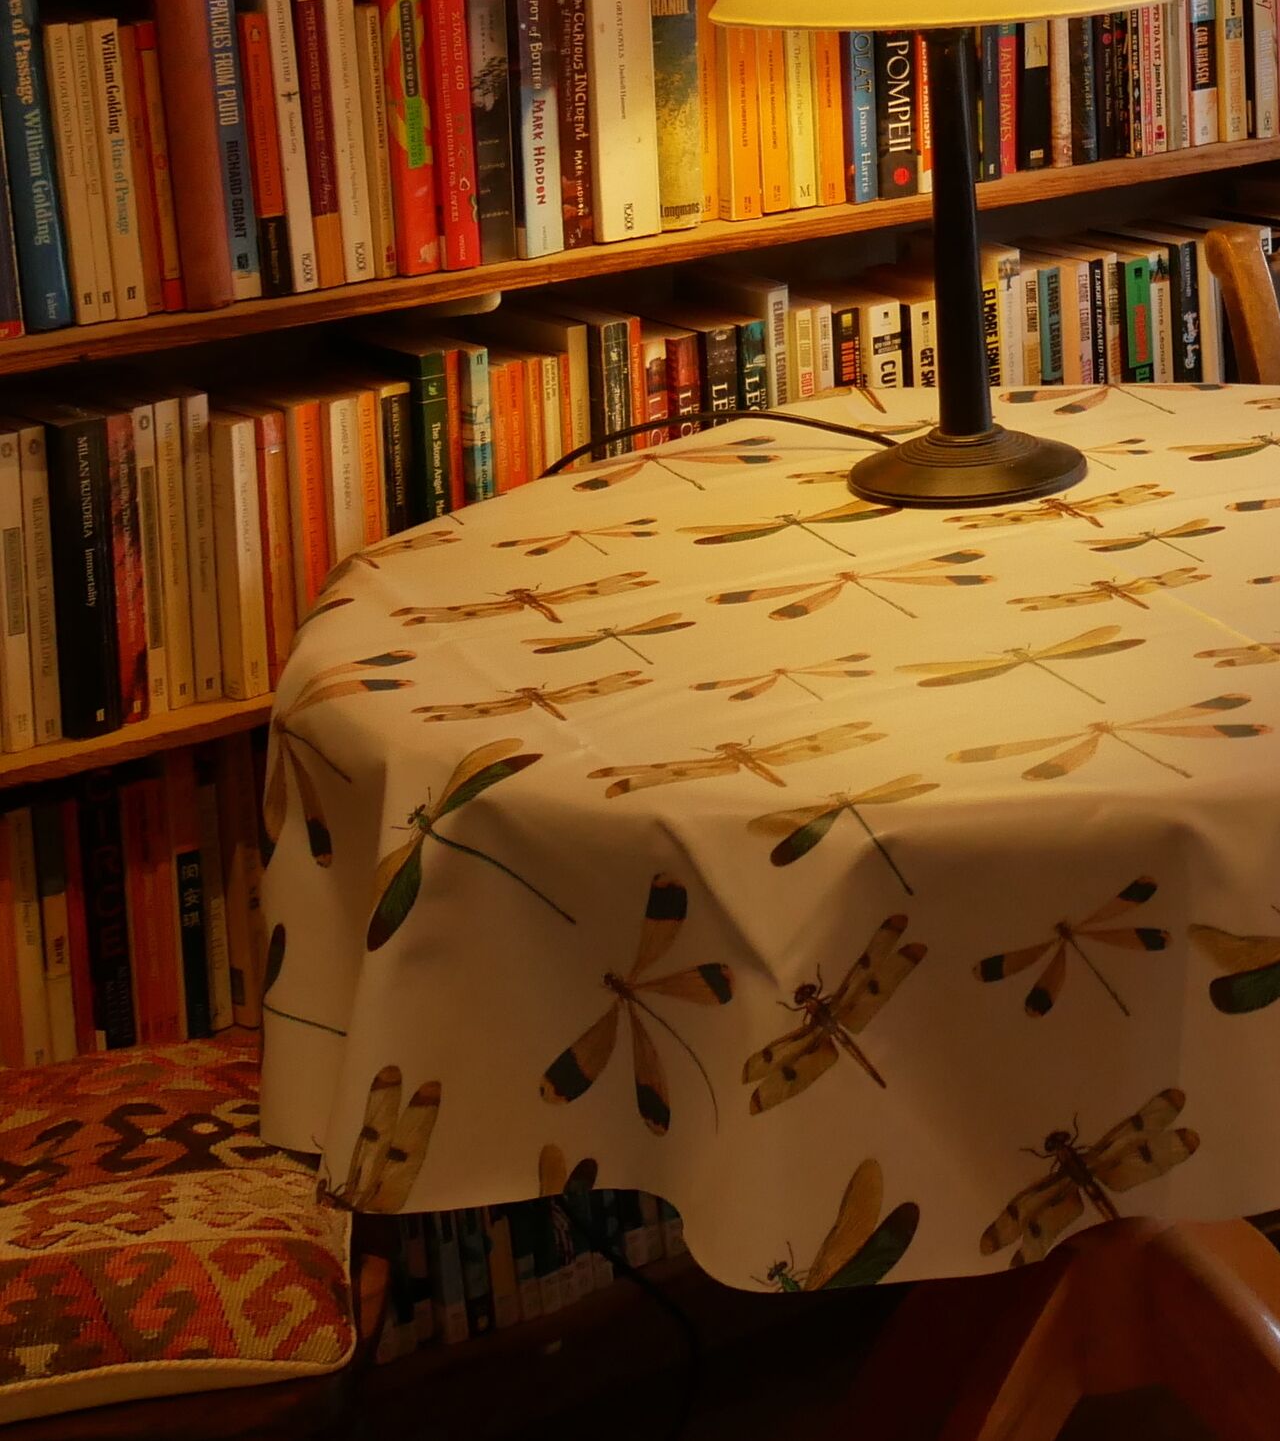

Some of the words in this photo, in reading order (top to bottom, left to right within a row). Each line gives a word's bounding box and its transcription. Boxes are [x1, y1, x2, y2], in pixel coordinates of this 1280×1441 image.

[11, 18, 28, 36] of
[573, 12, 586, 70] CURIOUS
[1195, 26, 1208, 47] CARL
[13, 39, 34, 105] Passage
[101, 32, 117, 84] William
[215, 54, 235, 87] FROM
[1000, 47, 1011, 89] JAMES
[106, 86, 121, 135] Golding
[218, 90, 239, 127] PLUTO
[532, 99, 545, 141] MARK
[575, 73, 588, 141] INCIDENT
[886, 40, 910, 153] POMPEII
[1001, 94, 1012, 142] HAWES
[24, 109, 44, 177] William
[857, 105, 870, 148] Joanne
[226, 141, 243, 193] RICHARD
[533, 147, 546, 206] HADDON
[860, 153, 872, 193] Harris
[30, 179, 50, 246] Golding
[231, 198, 247, 239] GRANT
[983, 289, 997, 337] ELMORE
[1048, 274, 1060, 318] ELMORE
[1094, 269, 1102, 301] ELMORE
[1098, 304, 1107, 348] LEONARD
[773, 301, 785, 348] ELMORE
[1049, 321, 1062, 372] LEONARD
[1158, 330, 1166, 374] Leonard
[775, 352, 788, 406] LEONARD
[77, 436, 89, 477] MILAN
[80, 479, 93, 538] KUNDERA
[84, 549, 97, 607] Immortality
